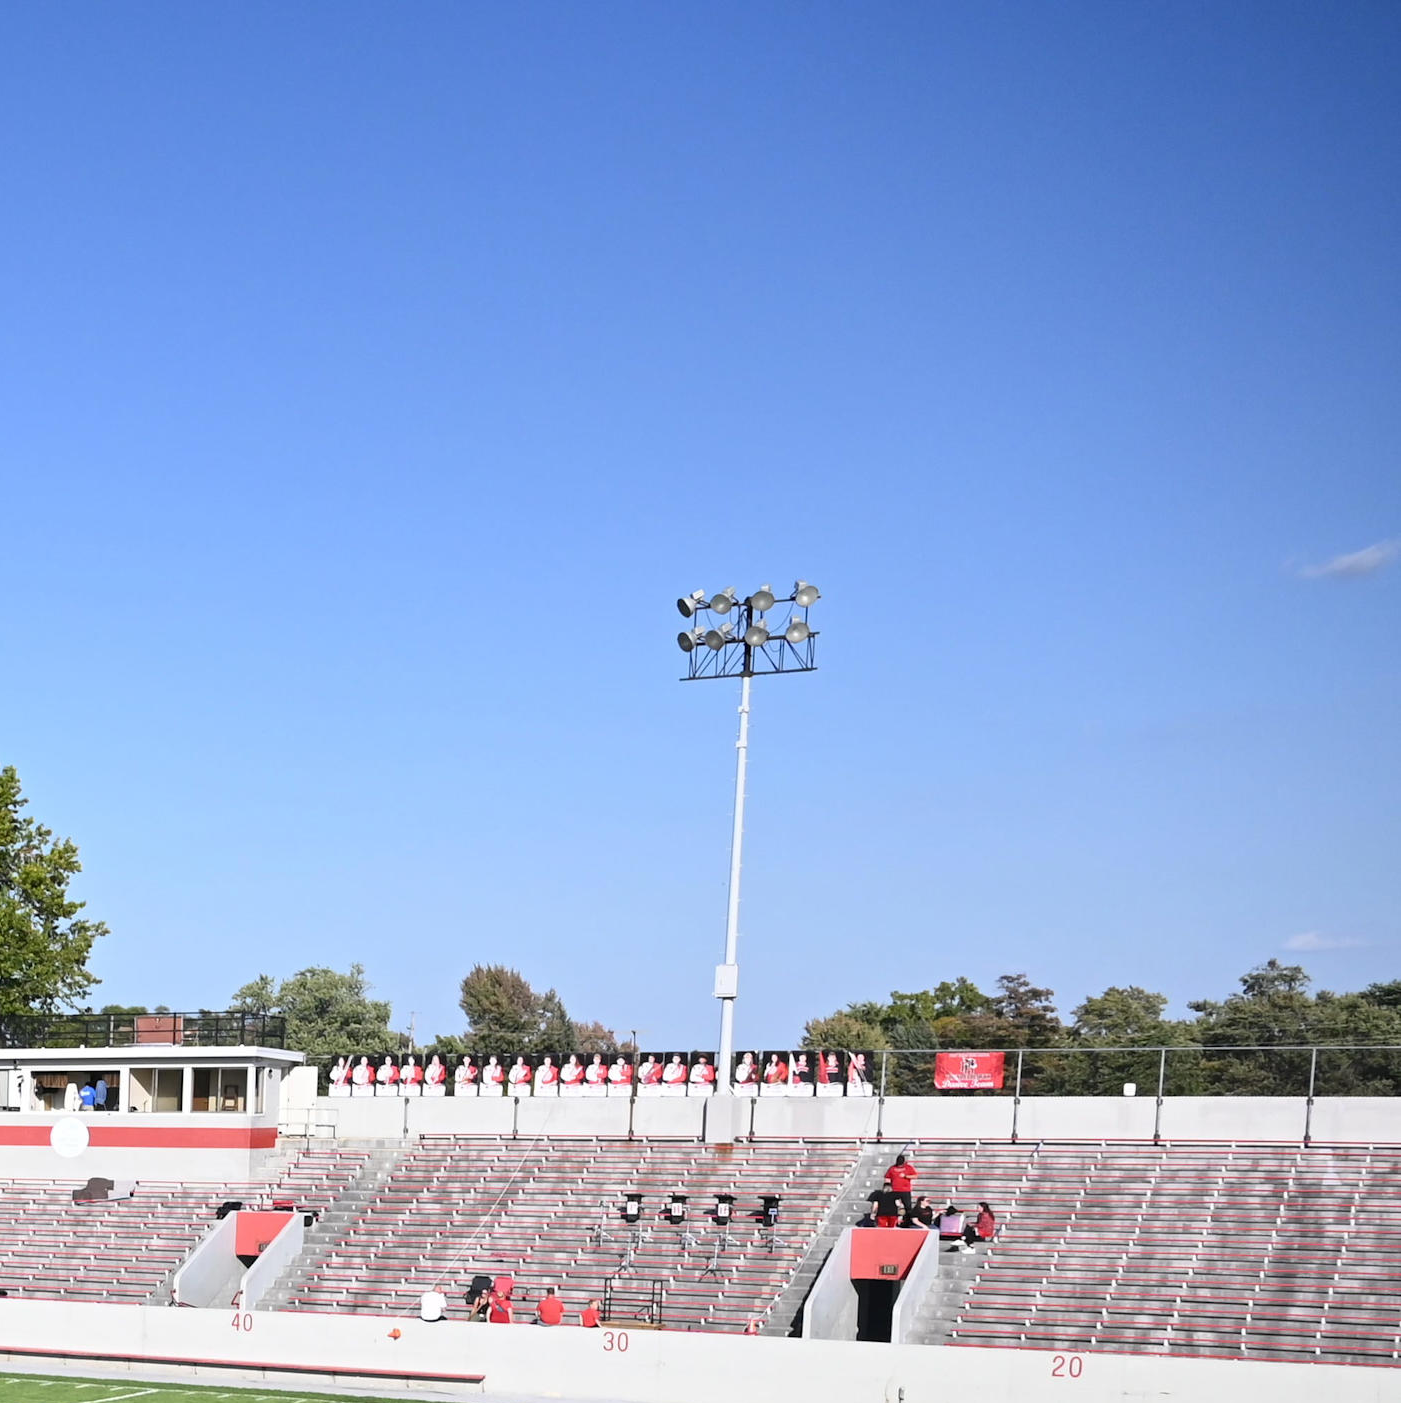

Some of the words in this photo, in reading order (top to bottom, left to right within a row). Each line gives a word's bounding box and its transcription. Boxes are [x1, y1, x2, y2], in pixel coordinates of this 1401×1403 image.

[231, 1313, 253, 1332] 40
[603, 1331, 629, 1352] 30
[1052, 1355, 1083, 1378] 20
